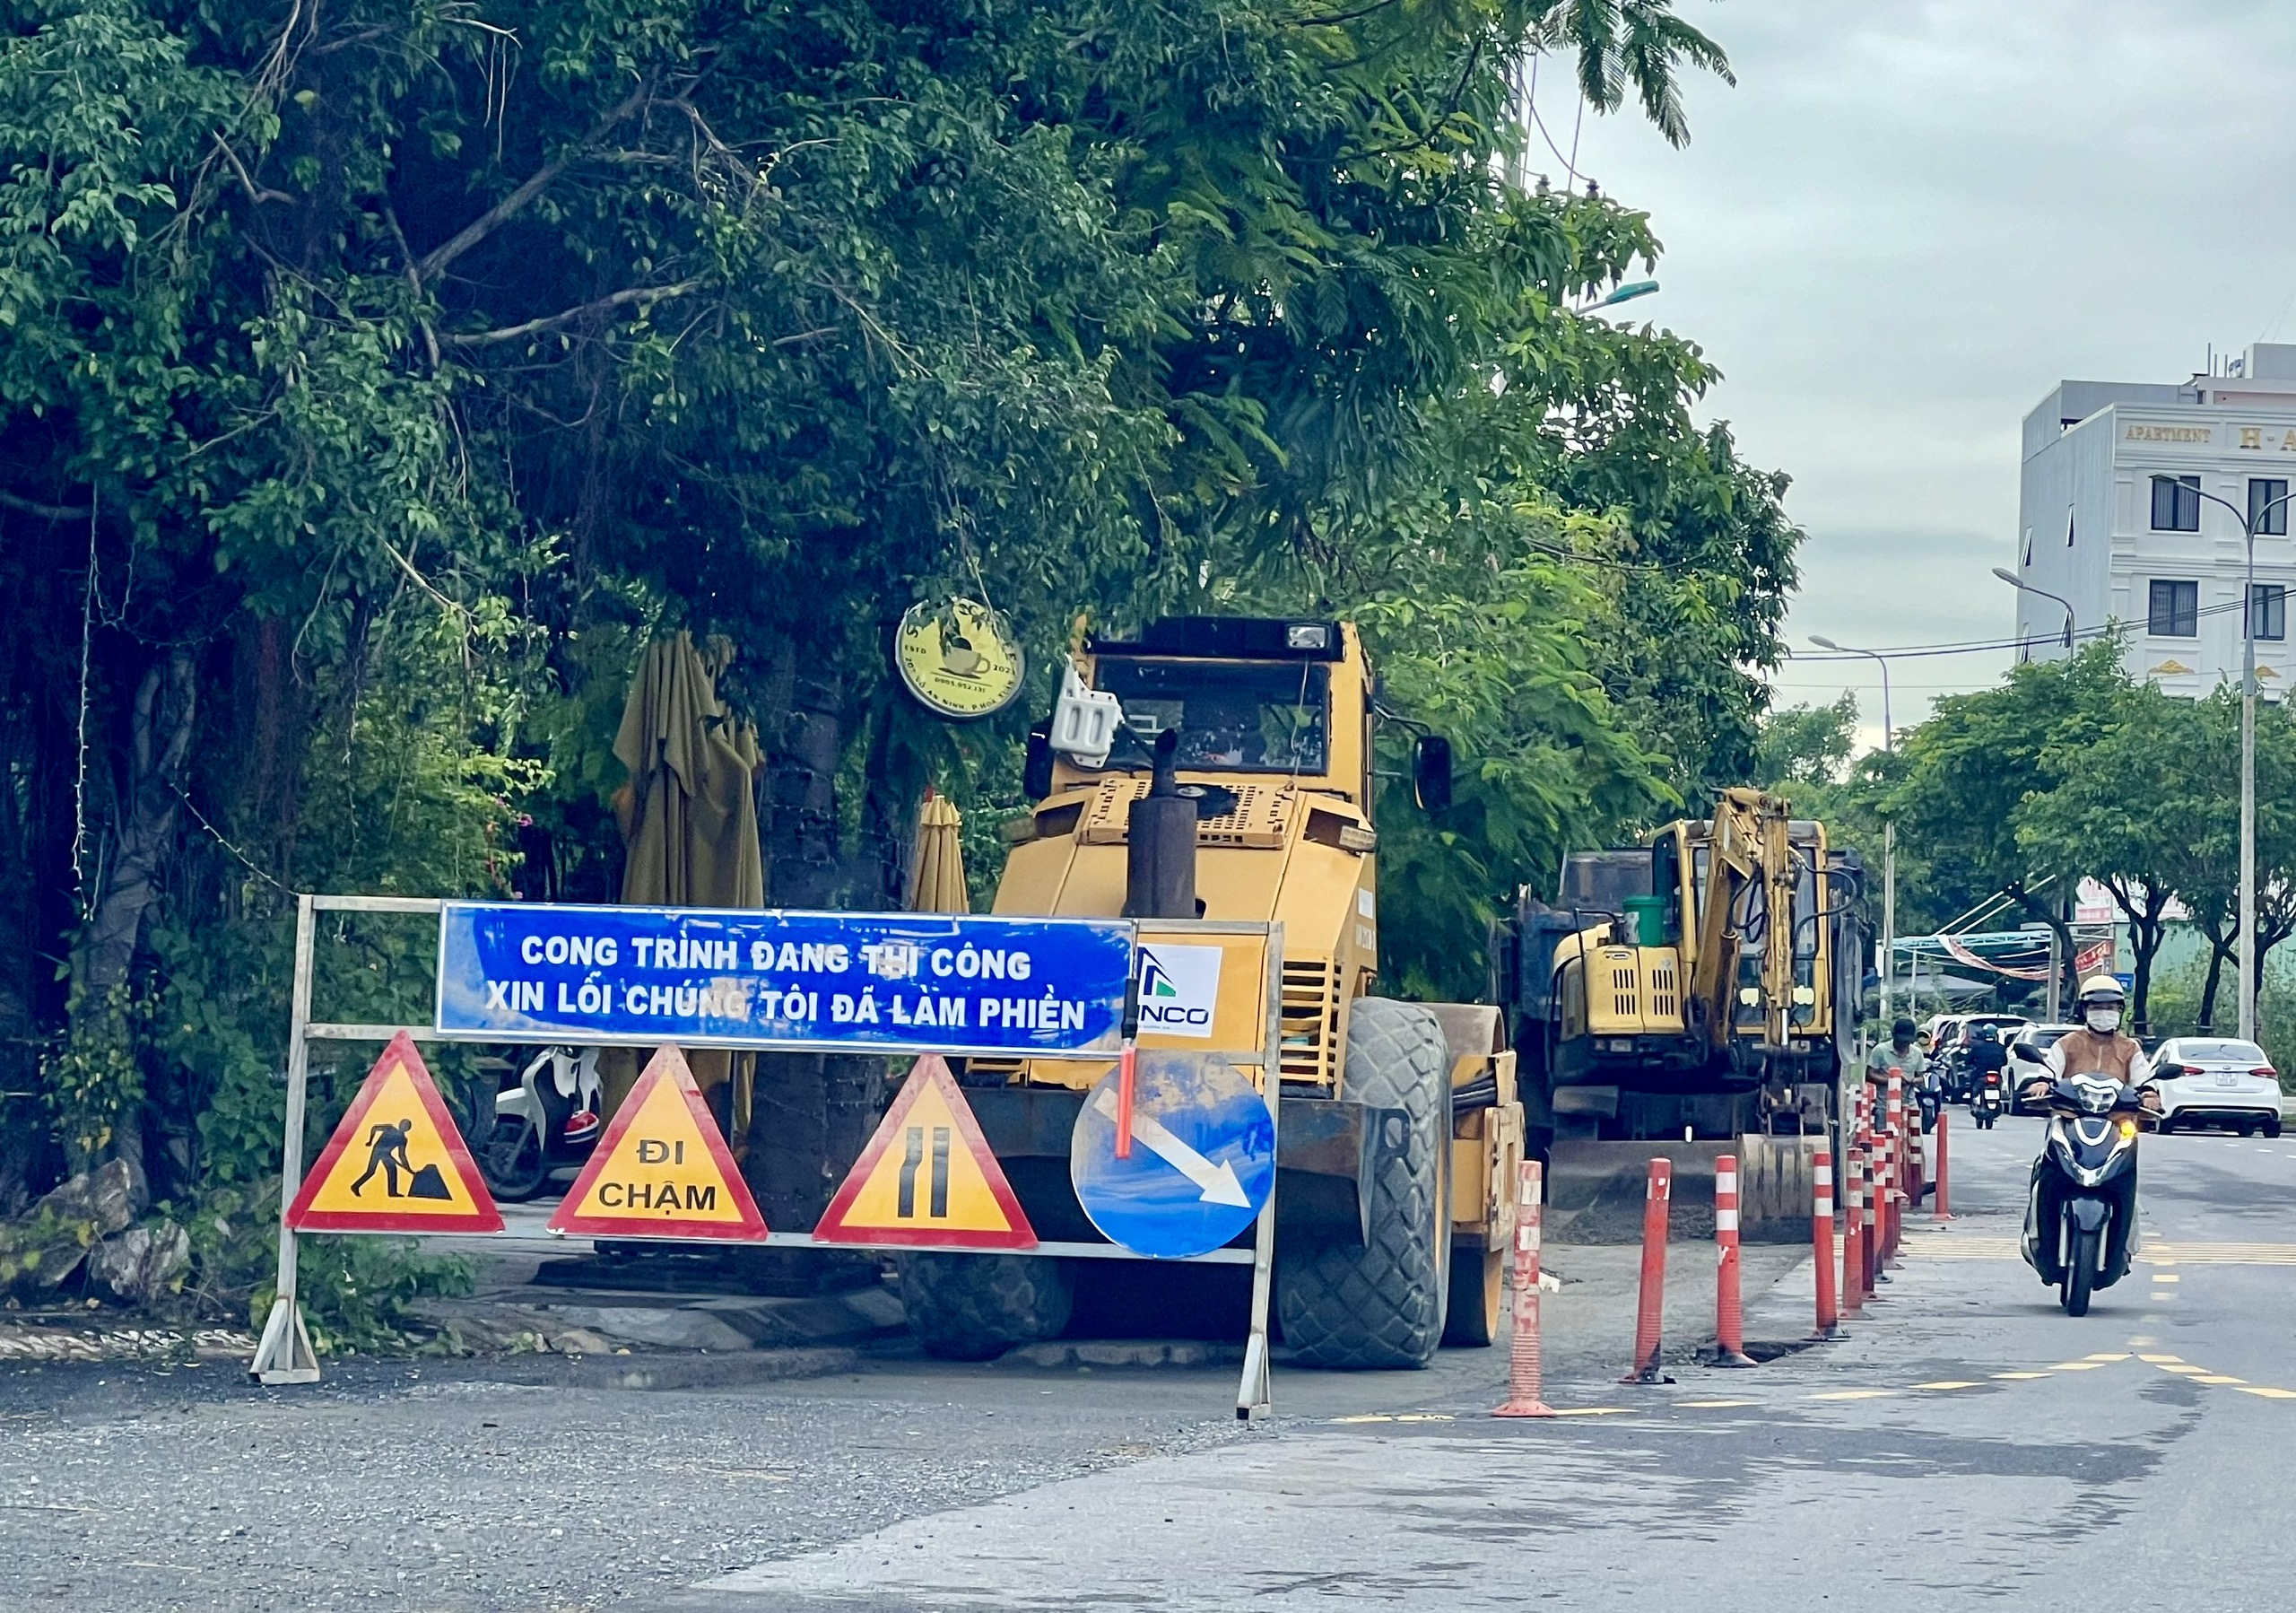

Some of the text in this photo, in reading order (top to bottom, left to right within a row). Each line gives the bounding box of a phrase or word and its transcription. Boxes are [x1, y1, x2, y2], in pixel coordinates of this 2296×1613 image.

[2125, 425, 2211, 443] APARTMENT
[904, 644, 926, 654] ESTD
[631, 929, 738, 970] TRÌNH
[751, 941, 849, 973] ĐANG
[861, 945, 918, 978] THI
[931, 941, 1031, 981] CÔNG
[485, 980, 544, 1011] XIN
[626, 979, 746, 1018] CHÚNG
[761, 983, 819, 1021] TÔI
[831, 985, 879, 1024] ĐÃ
[892, 984, 966, 1026] LÀM
[978, 984, 1085, 1030] PHIỀN
[637, 1138, 683, 1165] ĐI
[598, 1181, 716, 1216] CHẬM
